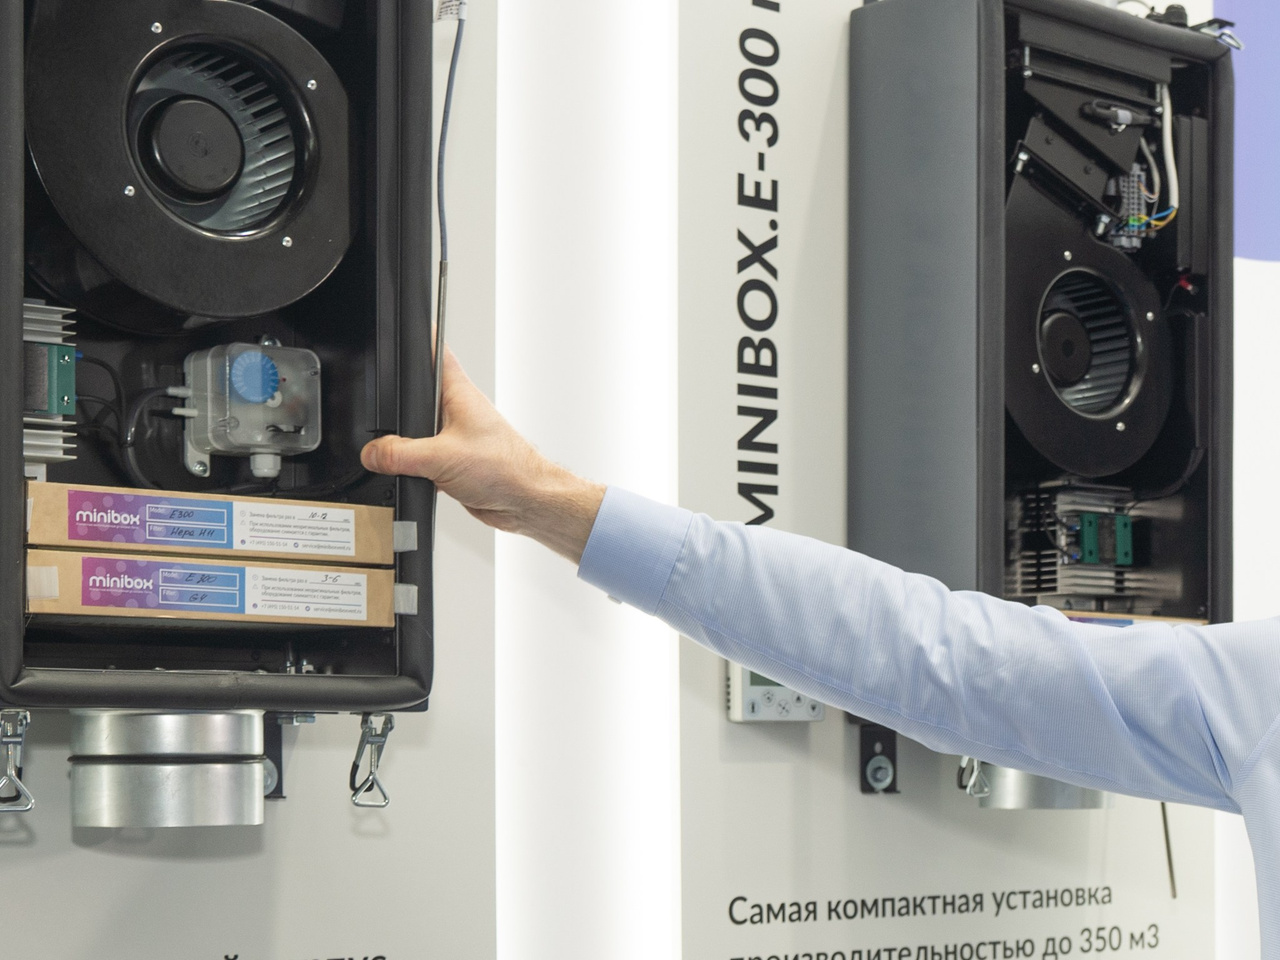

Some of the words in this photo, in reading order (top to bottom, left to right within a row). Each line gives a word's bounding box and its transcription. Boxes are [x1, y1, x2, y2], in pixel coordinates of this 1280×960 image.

[76, 508, 140, 525] minibox
[89, 573, 153, 590] minibox
[321, 574, 342, 583] 3-6
[728, 896, 818, 925] Самая
[827, 892, 984, 922] компактная
[991, 886, 1112, 918] установка
[1080, 926, 1122, 953] 350
[1129, 924, 1159, 950] м3
